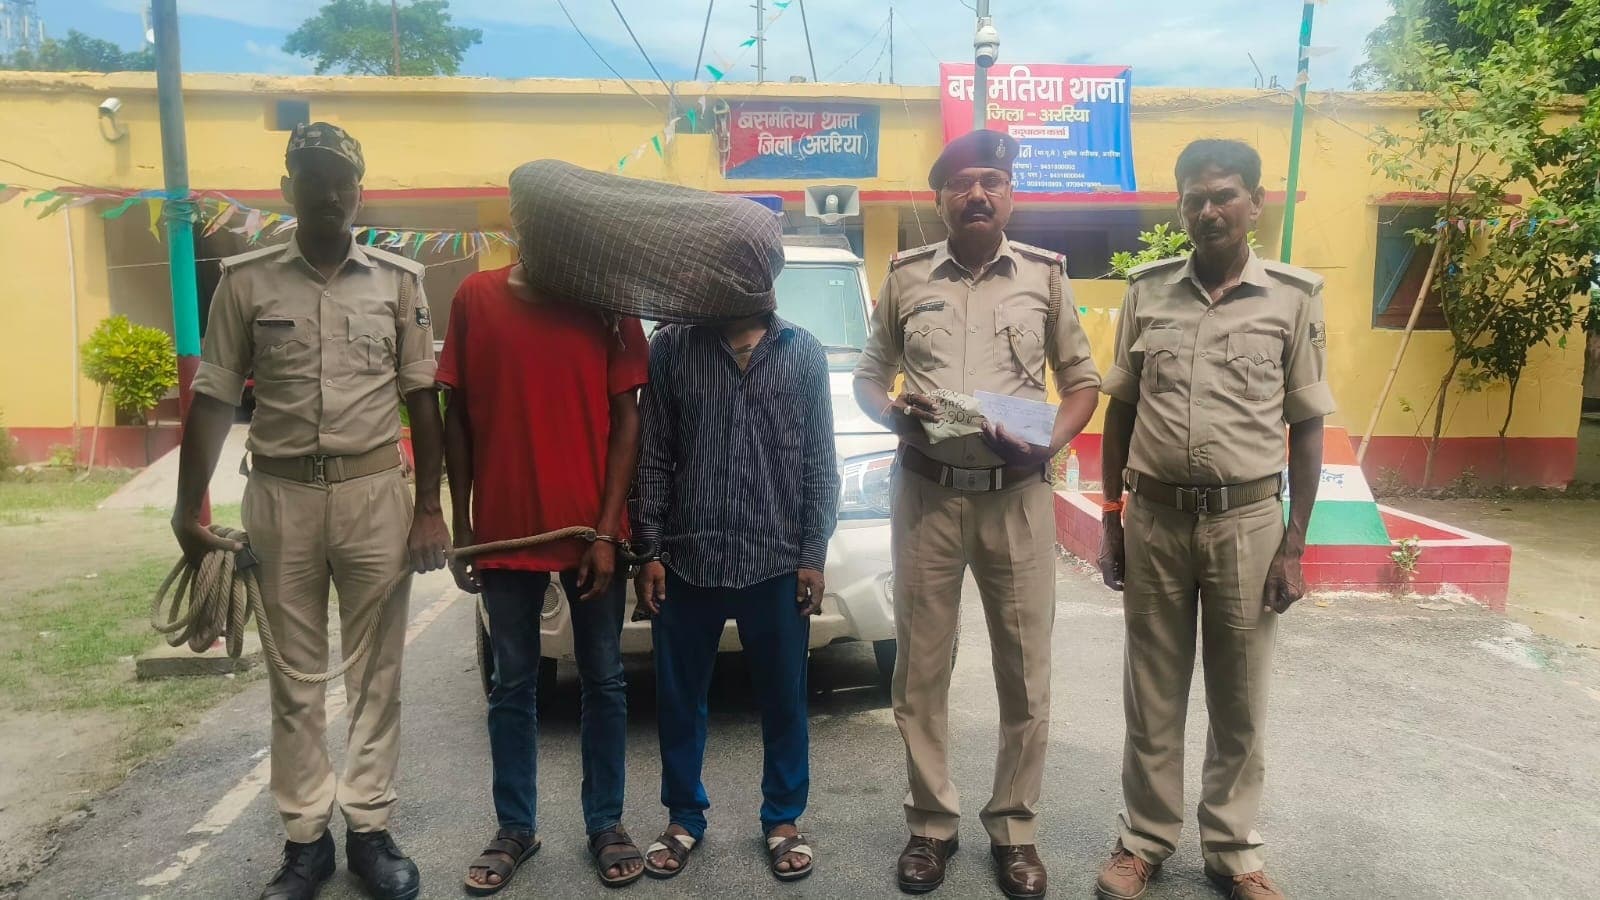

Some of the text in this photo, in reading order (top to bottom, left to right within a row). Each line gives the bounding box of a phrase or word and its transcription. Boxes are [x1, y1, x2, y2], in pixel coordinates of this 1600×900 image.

[1069, 77, 1126, 104] थाना
[738, 106, 860, 130] बसमतिया थाना
[986, 103, 1025, 122] जिला
[1039, 104, 1091, 123] अररिया
[757, 131, 869, 160] जिला (अररिया)
